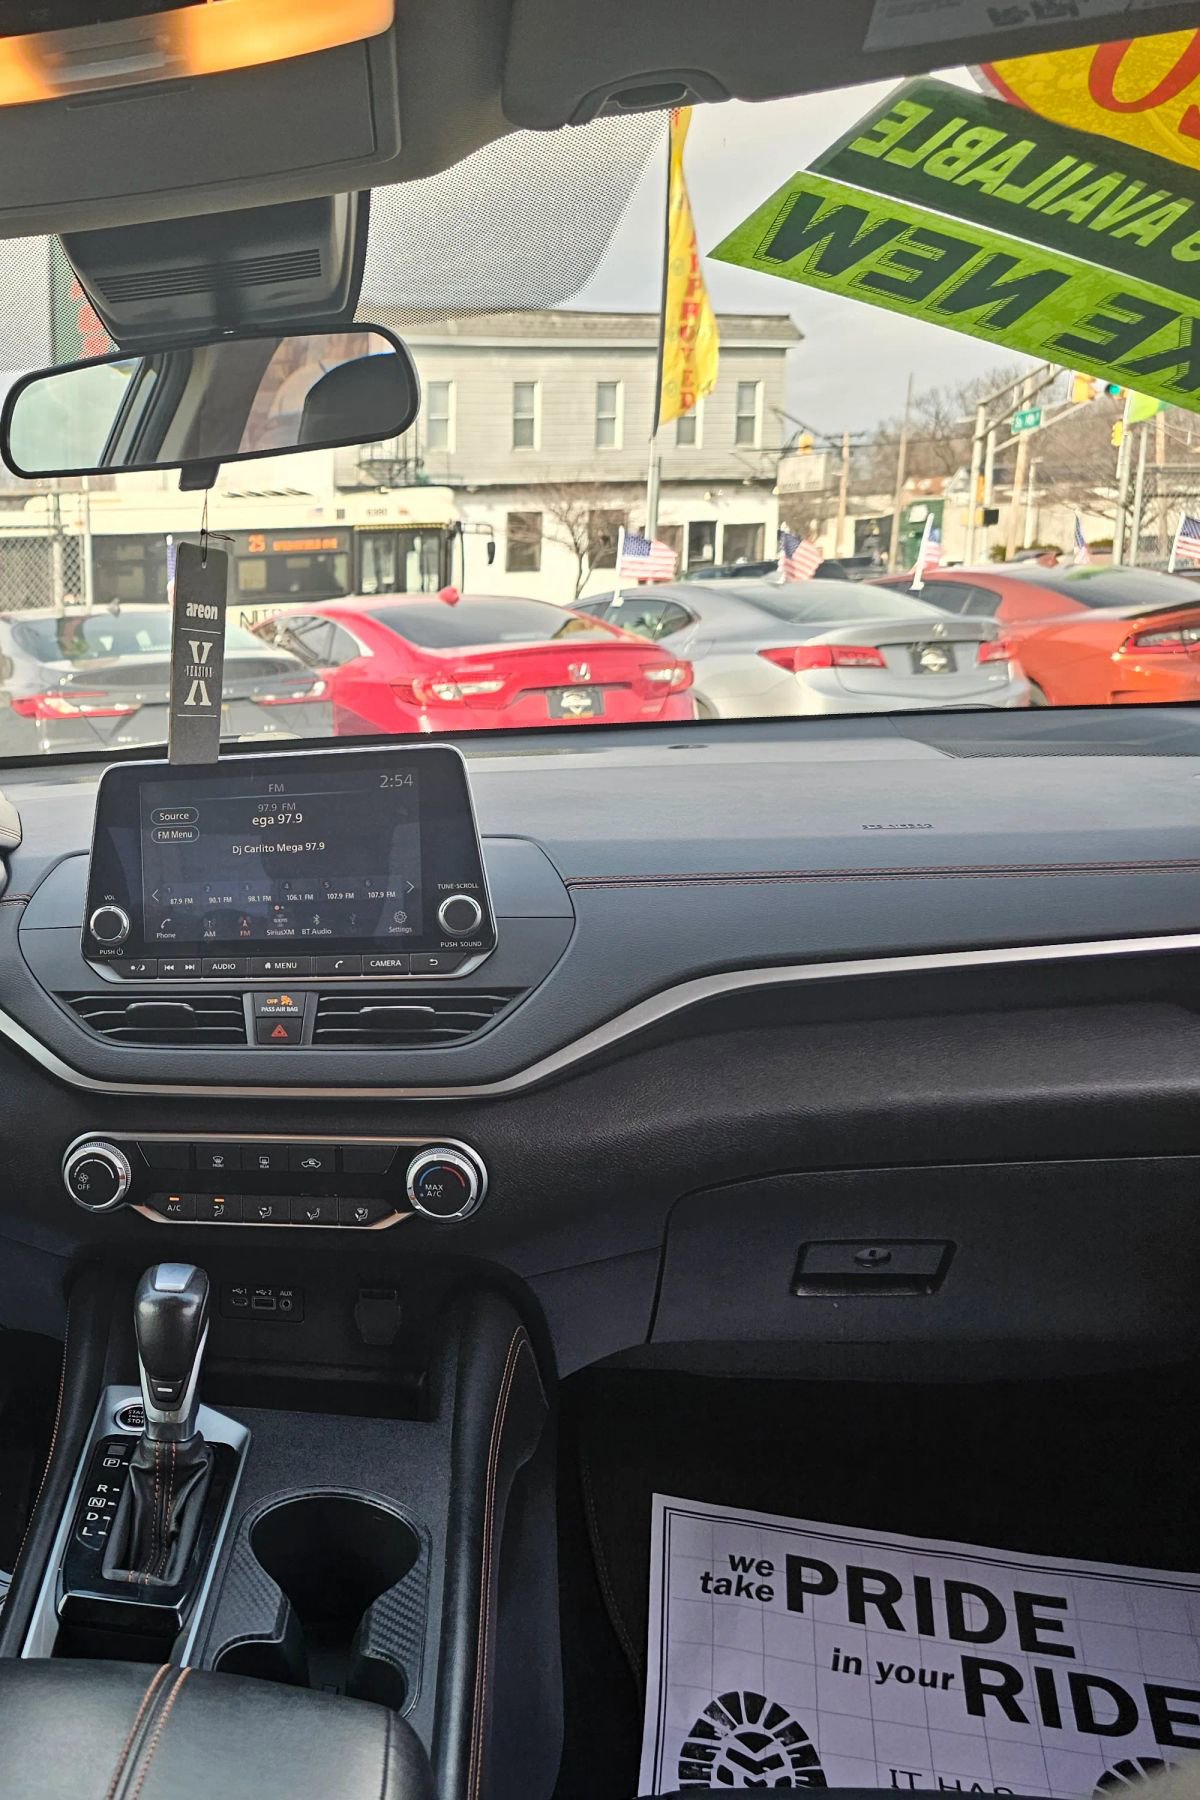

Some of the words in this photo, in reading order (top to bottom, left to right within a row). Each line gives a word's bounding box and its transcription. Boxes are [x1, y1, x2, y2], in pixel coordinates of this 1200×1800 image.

[186, 602, 218, 620] areon
[380, 774, 414, 788] 2:54
[268, 784, 284, 793] FM
[258, 803, 277, 812] 97.9
[282, 803, 296, 811] FM
[159, 812, 189, 821] Source
[252, 816, 274, 826] ega
[278, 813, 303, 824] 97.9
[158, 831, 169, 839] FM
[171, 830, 192, 839] Menu
[232, 846, 242, 855] Dj
[244, 843, 275, 853] Carlito
[277, 843, 303, 854] Mega
[305, 842, 325, 852] 97.9
[388, 926, 413, 934] Settings
[274, 961, 297, 969] MENU
[370, 959, 401, 967] CAMERA
[97, 1484, 107, 1493] R
[86, 1512, 98, 1520] D
[82, 1528, 92, 1536] L
[728, 1554, 775, 1577] we
[700, 1570, 775, 1603] take
[785, 1553, 1076, 1659] PRIDE
[831, 1647, 862, 1676] in
[875, 1661, 955, 1691] your
[960, 1654, 1200, 1749] RIDE
[889, 1769, 922, 1790] IT
